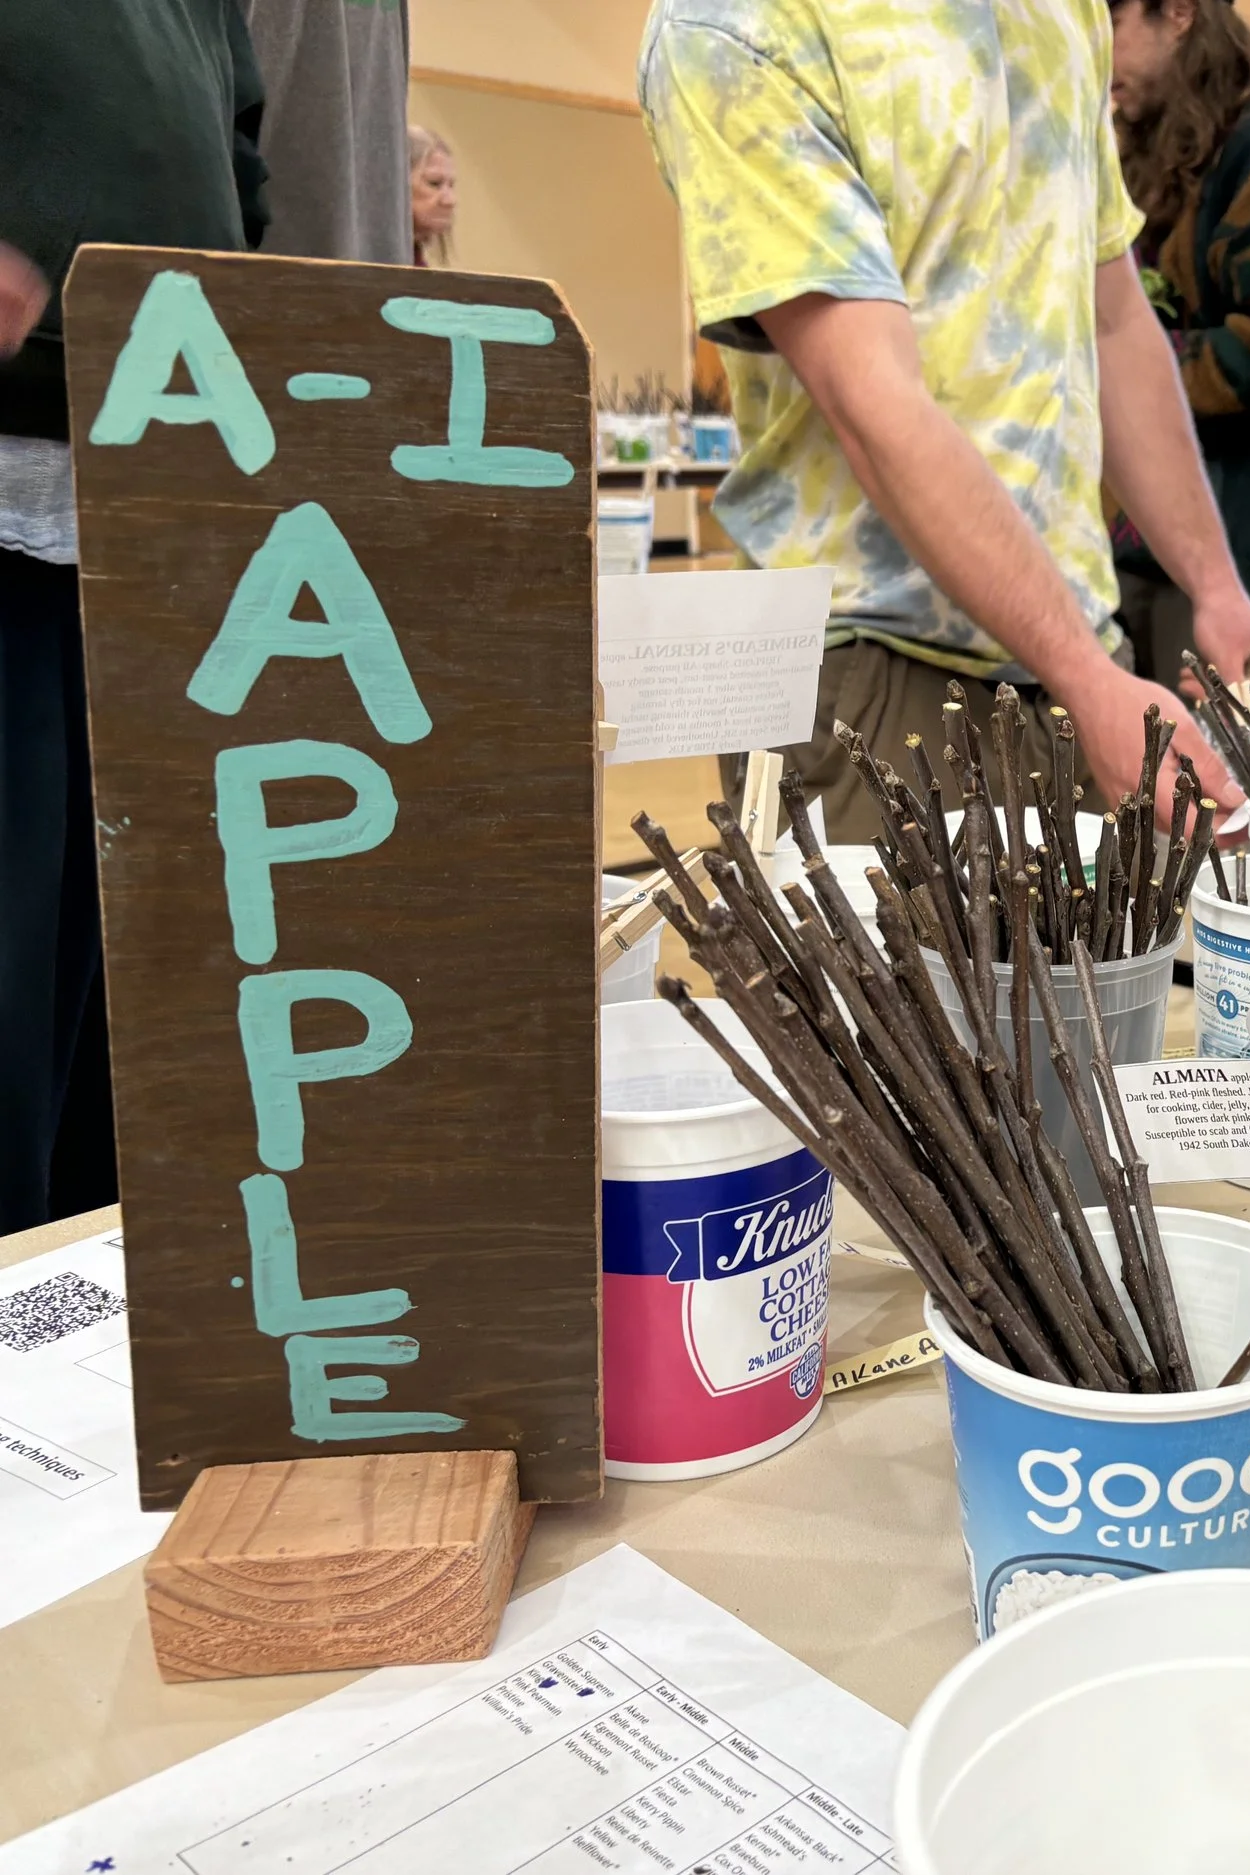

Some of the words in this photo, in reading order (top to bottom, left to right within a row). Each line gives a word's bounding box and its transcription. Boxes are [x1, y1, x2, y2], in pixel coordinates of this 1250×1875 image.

[1207, 934, 1242, 952] DIGESTIVE
[1220, 995, 1234, 1013] 41
[1152, 1068, 1229, 1085] ALMATA
[1125, 1093, 1148, 1102] Dark
[1150, 1091, 1167, 1101] red.
[1170, 1087, 1210, 1100] Red-pink
[1212, 1087, 1246, 1097] fleshed.
[1146, 1104, 1159, 1113] for
[1161, 1102, 1200, 1114] cooking,
[1202, 1101, 1226, 1112] cider,
[1227, 1100, 1250, 1111] jelly,
[1175, 1114, 1208, 1125] flowers
[1211, 1113, 1230, 1123] dark
[1145, 1126, 1196, 1140] Susceptible
[1198, 1128, 1207, 1137] to
[1209, 1125, 1229, 1136] scab
[1231, 1125, 1247, 1135] and
[1179, 1140, 1200, 1151] 1942
[1203, 1139, 1228, 1149] South
[762, 1260, 813, 1300] LOW
[748, 1354, 764, 1372] 2%
[766, 1331, 806, 1364] MILKFAT
[918, 1337, 939, 1356] A
[6, 1439, 85, 1481] techniques
[588, 1635, 610, 1650] Early
[526, 1668, 543, 1684] King
[556, 1652, 584, 1673] Golden
[582, 1670, 615, 1698] Supreme
[496, 1685, 525, 1707] Pristine
[512, 1677, 530, 1692] Pink
[527, 1687, 562, 1717] Pearmain
[655, 1685, 678, 1706] Early
[680, 1702, 710, 1725] Middle
[481, 1693, 515, 1722] William's
[513, 1716, 534, 1736] Pride
[609, 1713, 630, 1730] Belle
[628, 1728, 640, 1738] de
[624, 1705, 650, 1725] Akane
[580, 1730, 612, 1757] Wickson
[594, 1721, 632, 1752] Egremont
[630, 1748, 658, 1770] Russet
[728, 1737, 759, 1762] Middle
[564, 1738, 609, 1776] Wynoochee
[697, 1758, 724, 1780] Brown
[652, 1786, 678, 1807] Fiesta
[667, 1776, 693, 1796] Elstar
[682, 1768, 723, 1800] Cinnamon
[721, 1796, 745, 1815] Spice
[620, 1805, 651, 1829] Liberty
[636, 1796, 660, 1815] Kerry
[660, 1812, 686, 1835] Pippin
[806, 1791, 839, 1817] Middle
[842, 1820, 864, 1837] Late
[589, 1825, 618, 1848] Yellow
[605, 1815, 630, 1835] Reine
[628, 1833, 641, 1844] de
[638, 1840, 676, 1869] Reinette
[760, 1823, 808, 1861] Ashmead's
[775, 1814, 813, 1845] Arkansas
[730, 1843, 771, 1875] Braeburn
